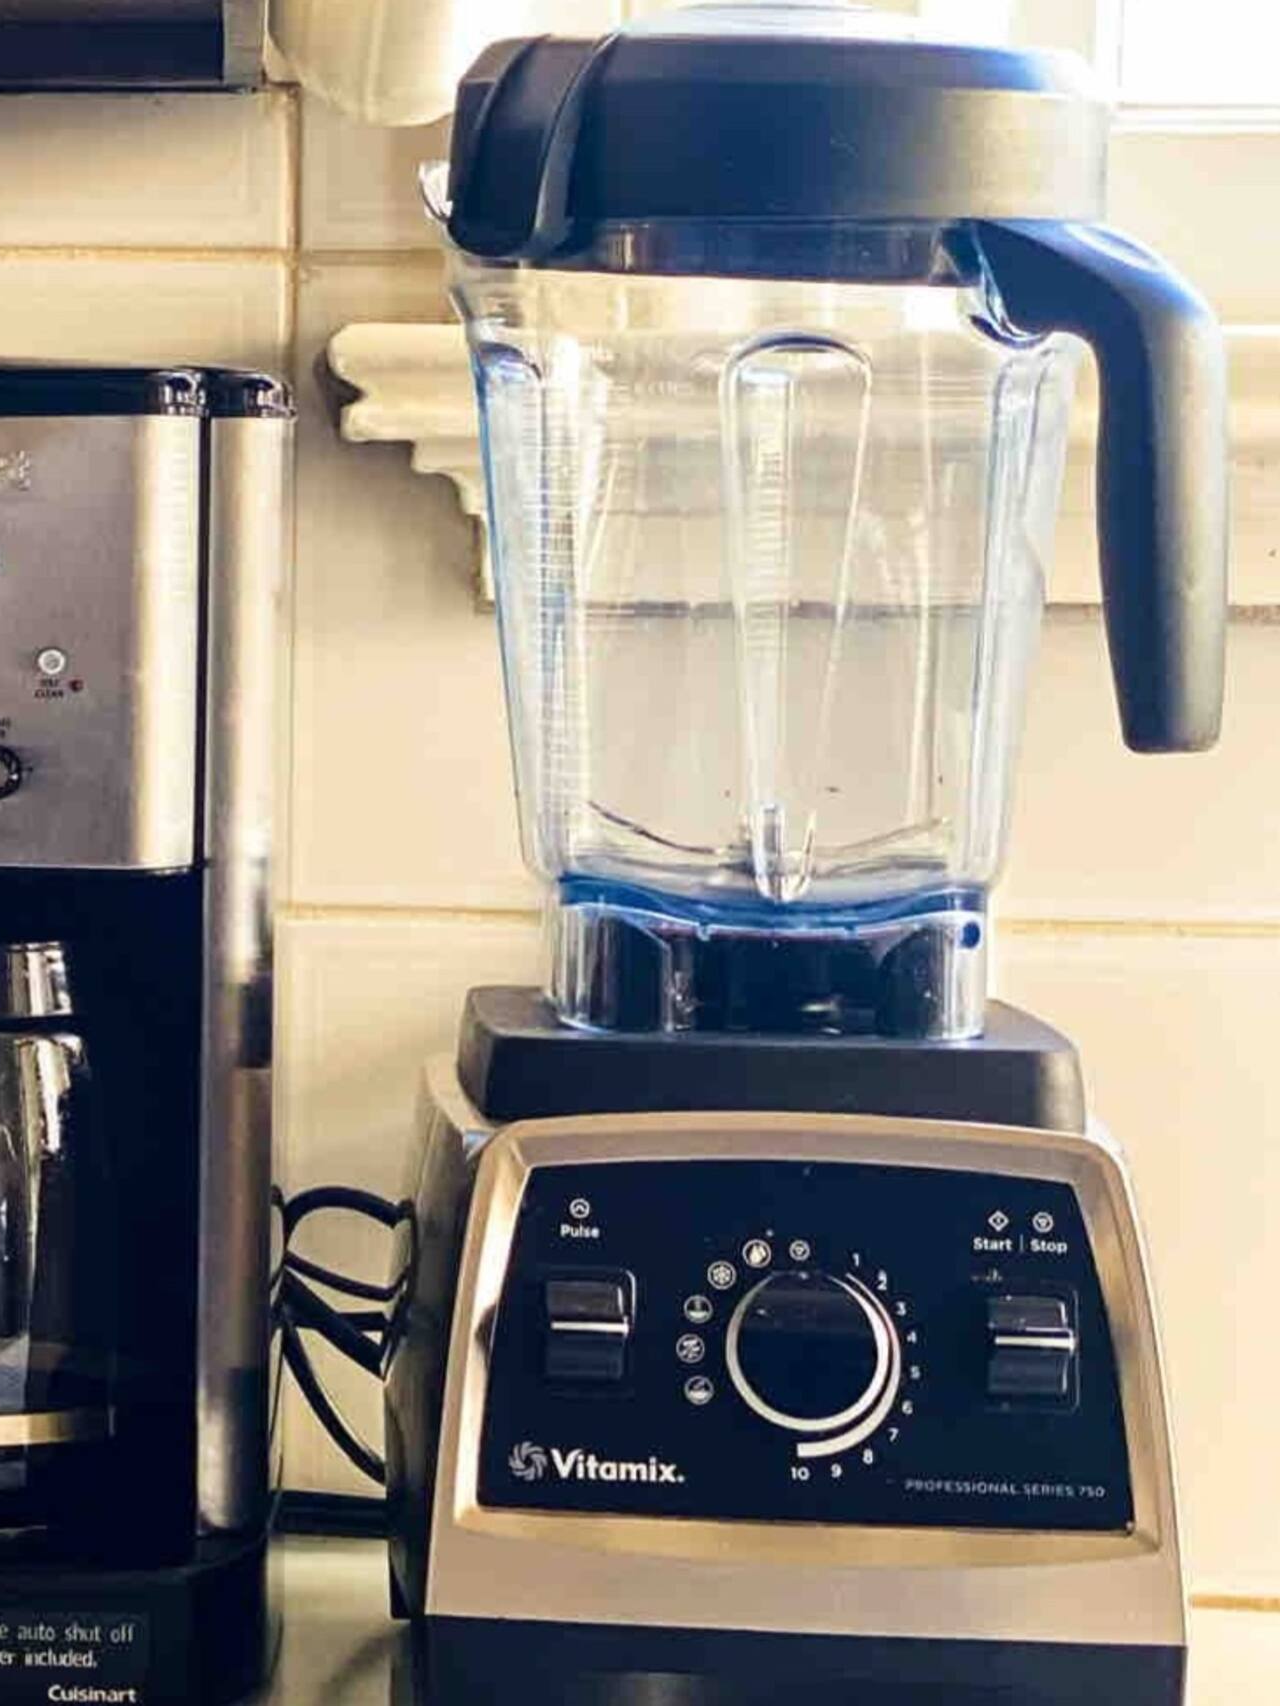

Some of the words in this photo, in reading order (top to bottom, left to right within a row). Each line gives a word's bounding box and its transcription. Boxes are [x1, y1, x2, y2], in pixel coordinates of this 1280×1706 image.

[560, 1223, 600, 1239] Pulse
[973, 1236, 1012, 1251] Start
[1030, 1238, 1068, 1255] Stop
[852, 1253, 860, 1267] 1
[895, 1302, 907, 1316] 3
[907, 1332, 917, 1344] 4
[910, 1365, 921, 1379] 5
[901, 1401, 913, 1415] 6
[888, 1428, 899, 1441] 7
[862, 1449, 874, 1465] 8
[790, 1467, 810, 1481] 10
[830, 1464, 842, 1478] 9
[904, 1479, 1018, 1495] PROFESSIONAL
[1023, 1483, 1075, 1497] SERIES
[1078, 1486, 1106, 1498] 750
[17, 1624, 56, 1641] auto
[64, 1625, 101, 1643] shut
[110, 1624, 136, 1644] off
[46, 1683, 138, 1704] Cuisinart
